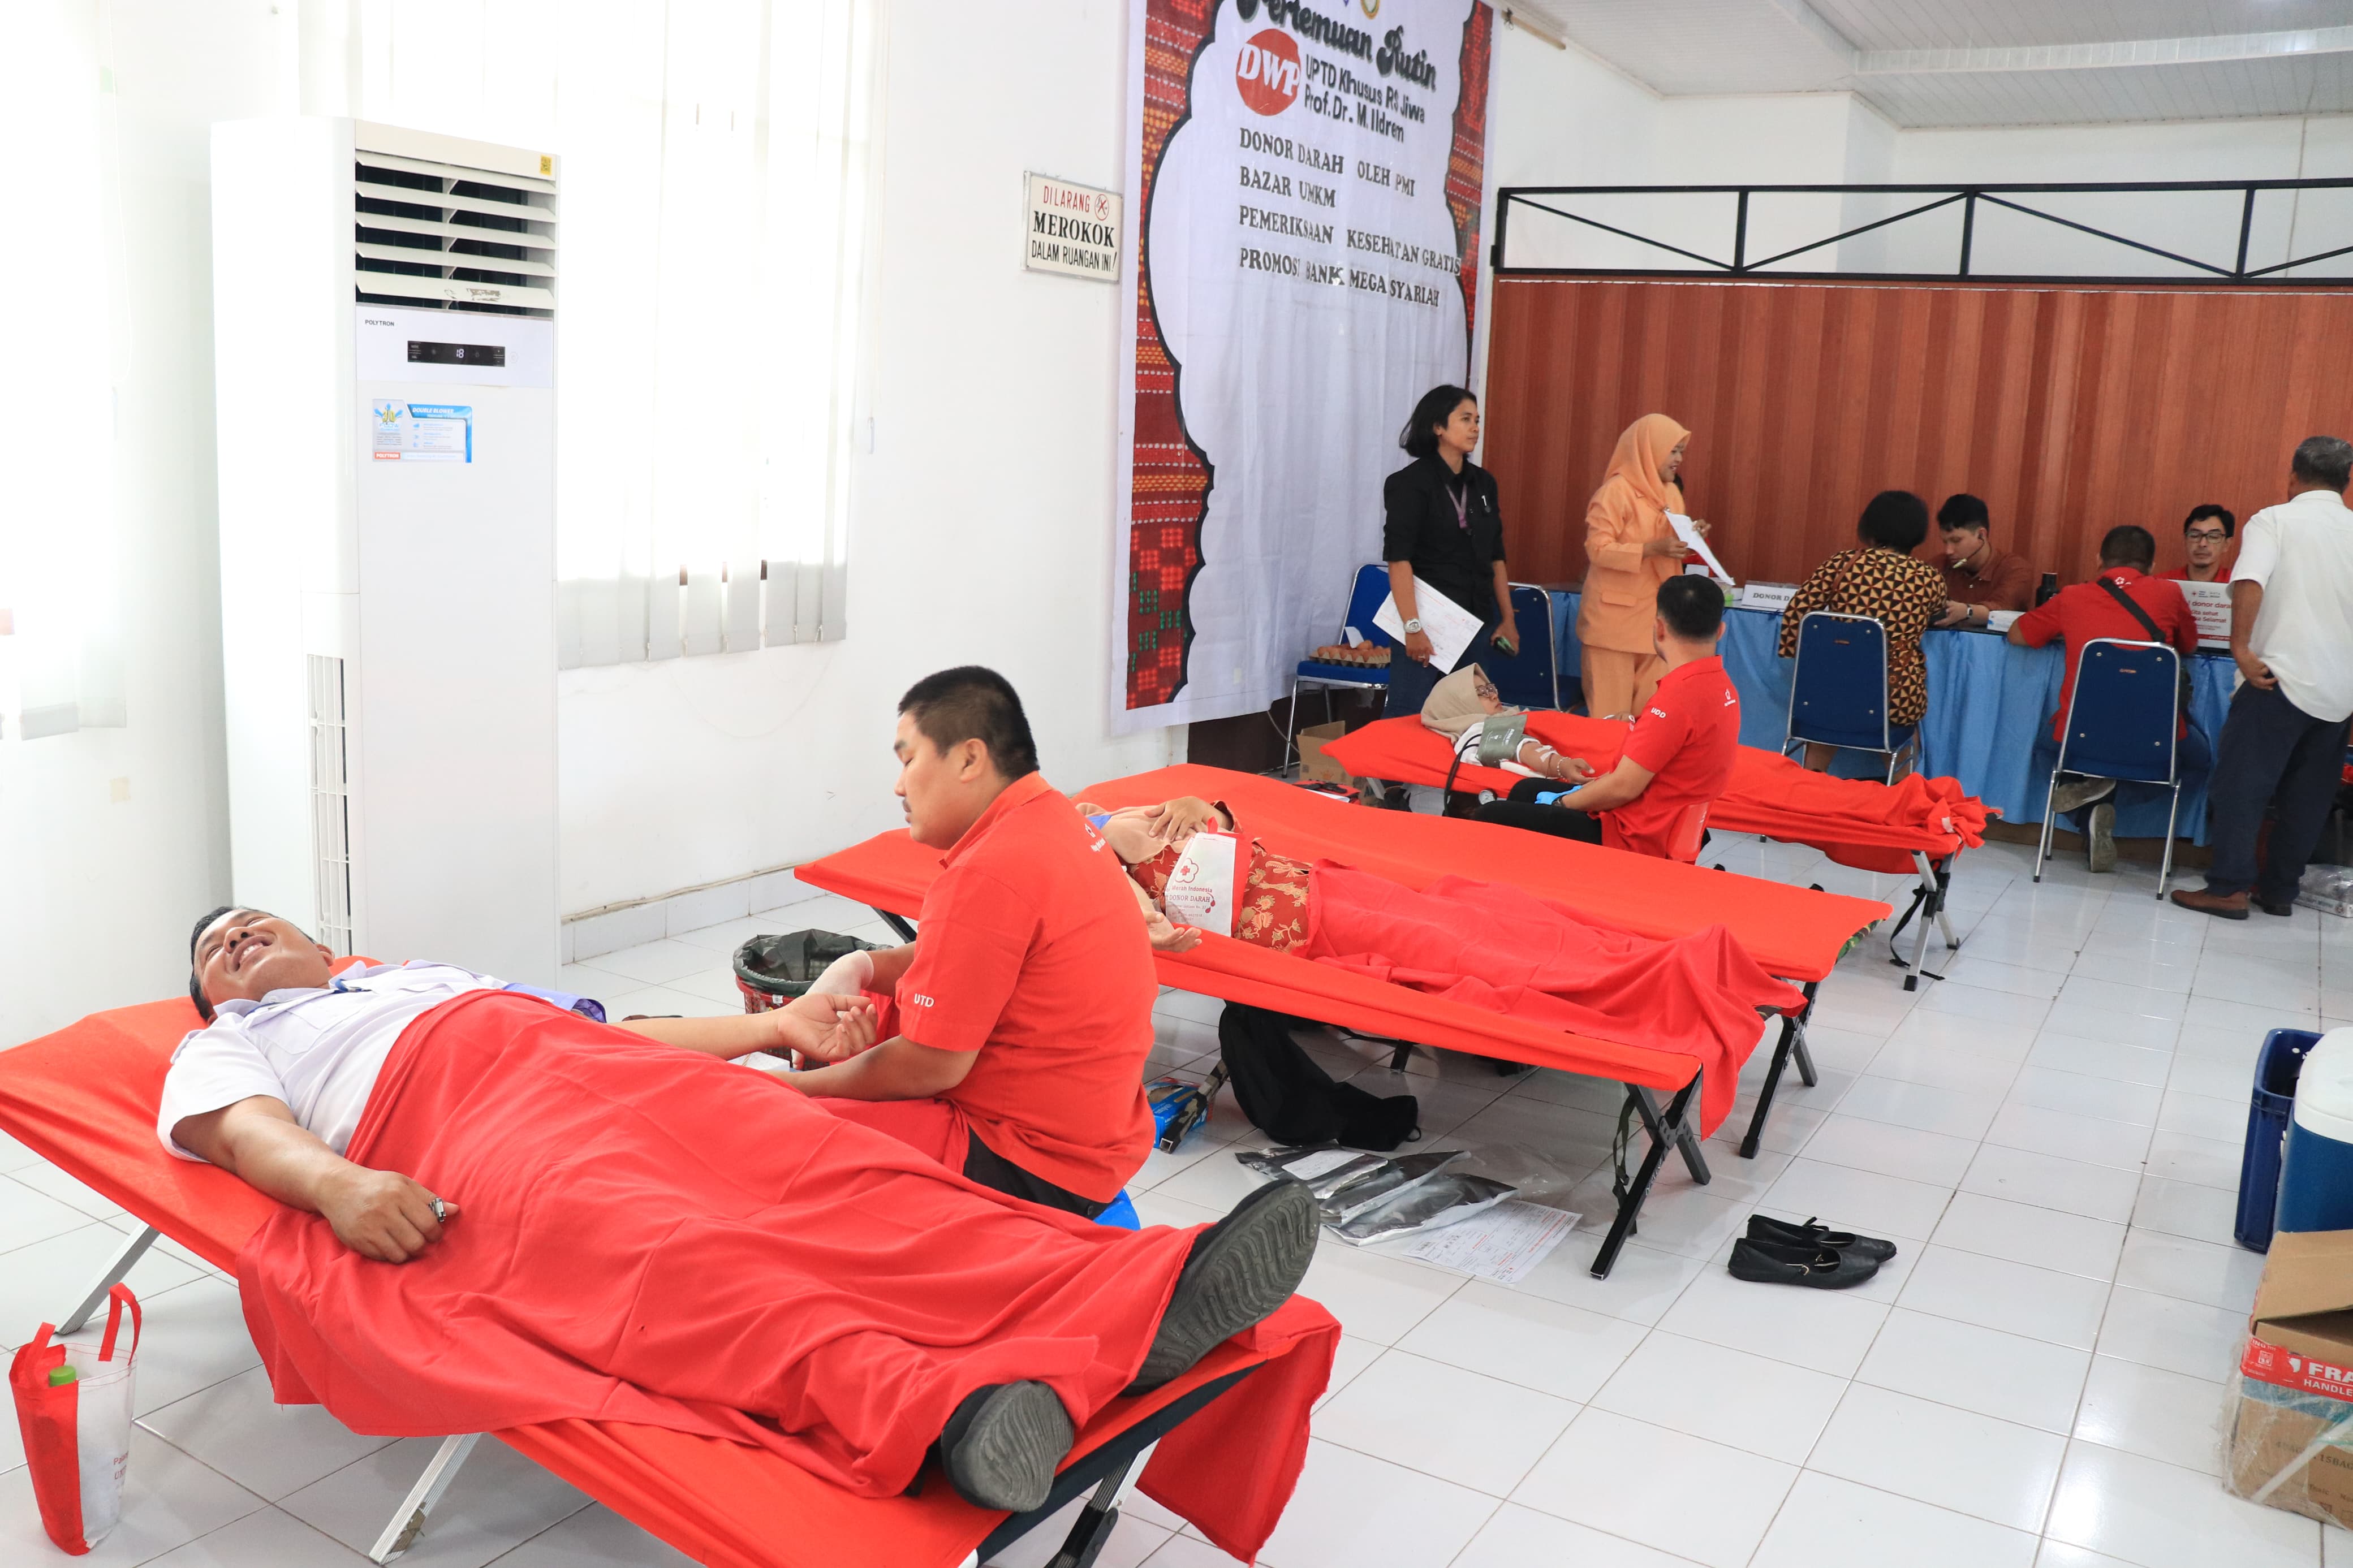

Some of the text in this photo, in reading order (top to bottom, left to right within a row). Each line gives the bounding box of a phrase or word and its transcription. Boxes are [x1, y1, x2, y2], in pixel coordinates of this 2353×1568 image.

[1238, 45, 1300, 97] DWP
[1376, 25, 1437, 94] Rutin
[1306, 54, 1425, 124] UPTD Khusus RS Jiwa
[1240, 127, 1415, 197] DONOR DARAH OLEH PMI
[1043, 185, 1091, 213] DILARANG
[1240, 166, 1336, 208] BAZAR UMKM
[1033, 210, 1115, 248] MEROKOK
[1239, 205, 1460, 275] PEMERIKSAAN KESEHATAN GRATIS
[1032, 240, 1059, 262] DALAM
[1063, 245, 1100, 270] RUANGAN
[1240, 247, 1440, 308] PROMOSI BANK MEGA SYARIAH
[456, 348, 464, 358] 18
[1650, 707, 1666, 718] UDD
[914, 993, 934, 1007] UTD
